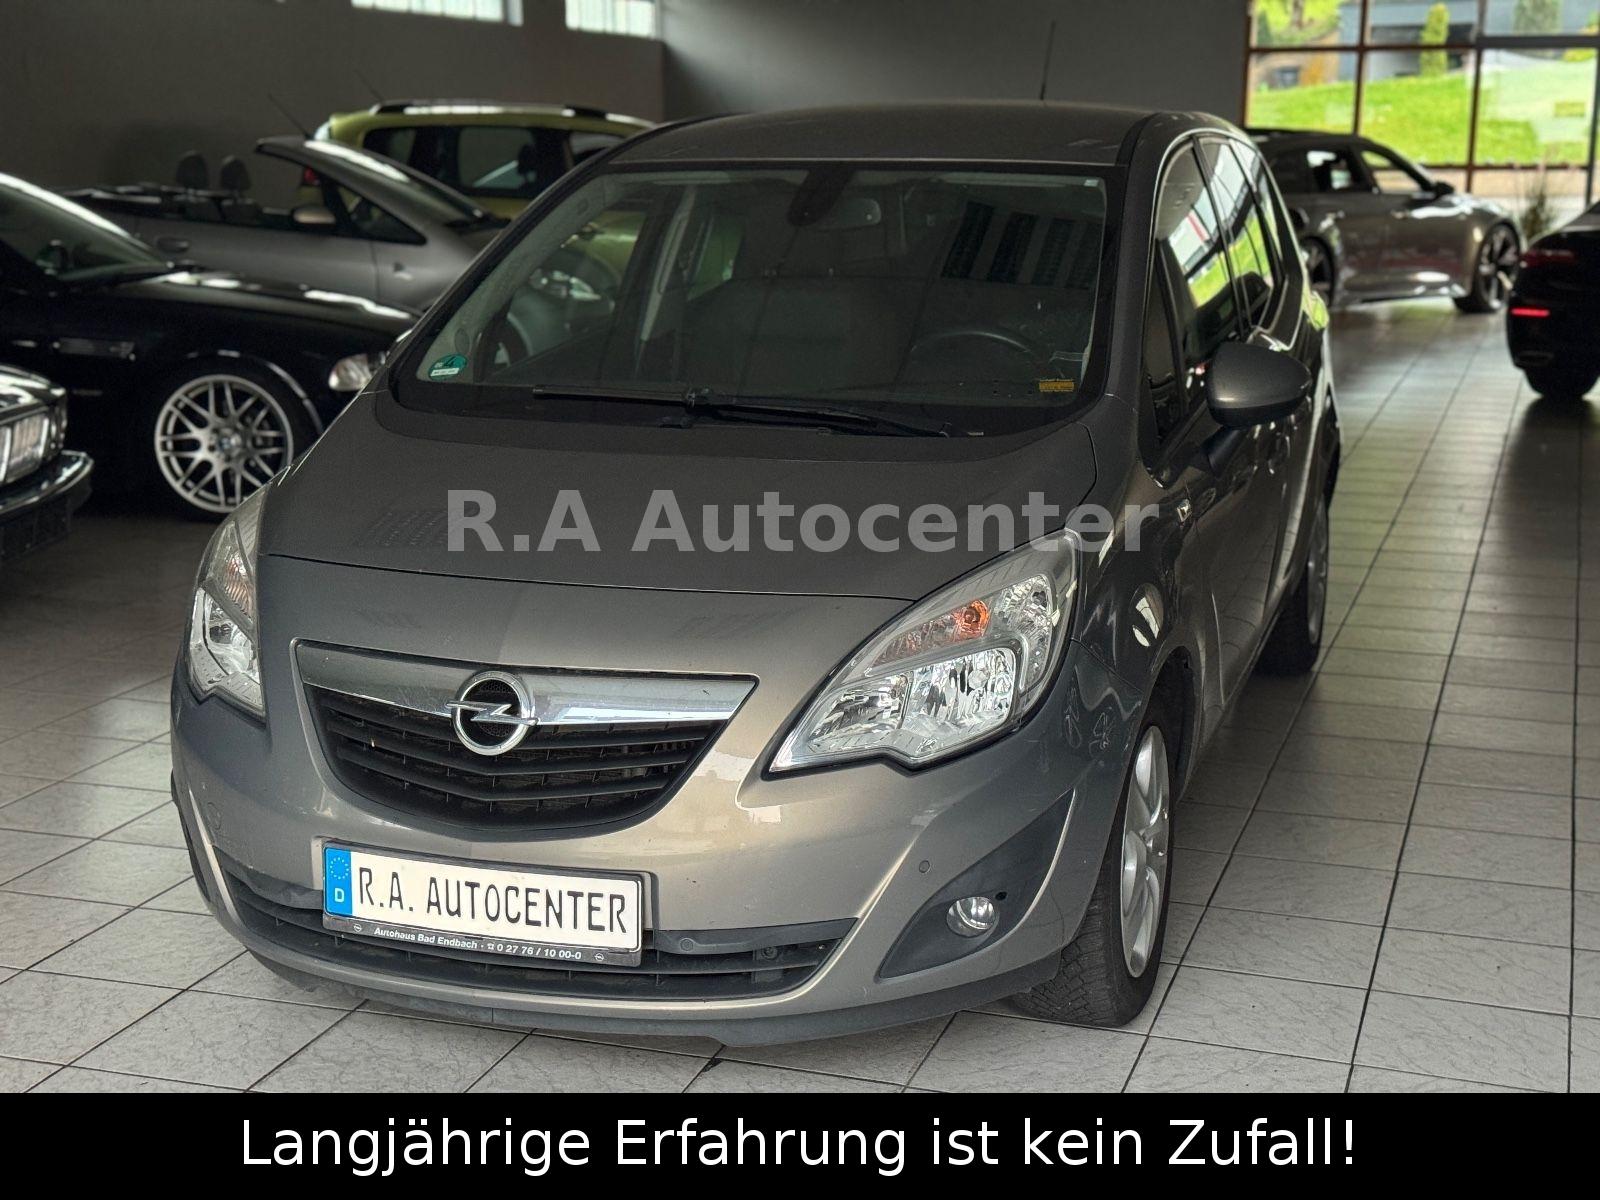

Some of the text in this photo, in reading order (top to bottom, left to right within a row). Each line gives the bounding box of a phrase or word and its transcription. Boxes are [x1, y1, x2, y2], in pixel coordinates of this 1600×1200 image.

[334, 887, 346, 903] D
[359, 866, 628, 934] R.A. AUTOCENTER
[373, 926, 416, 941] Autohaus
[417, 933, 436, 944] Bad
[437, 936, 478, 949] Endbach
[505, 944, 519, 954] 27
